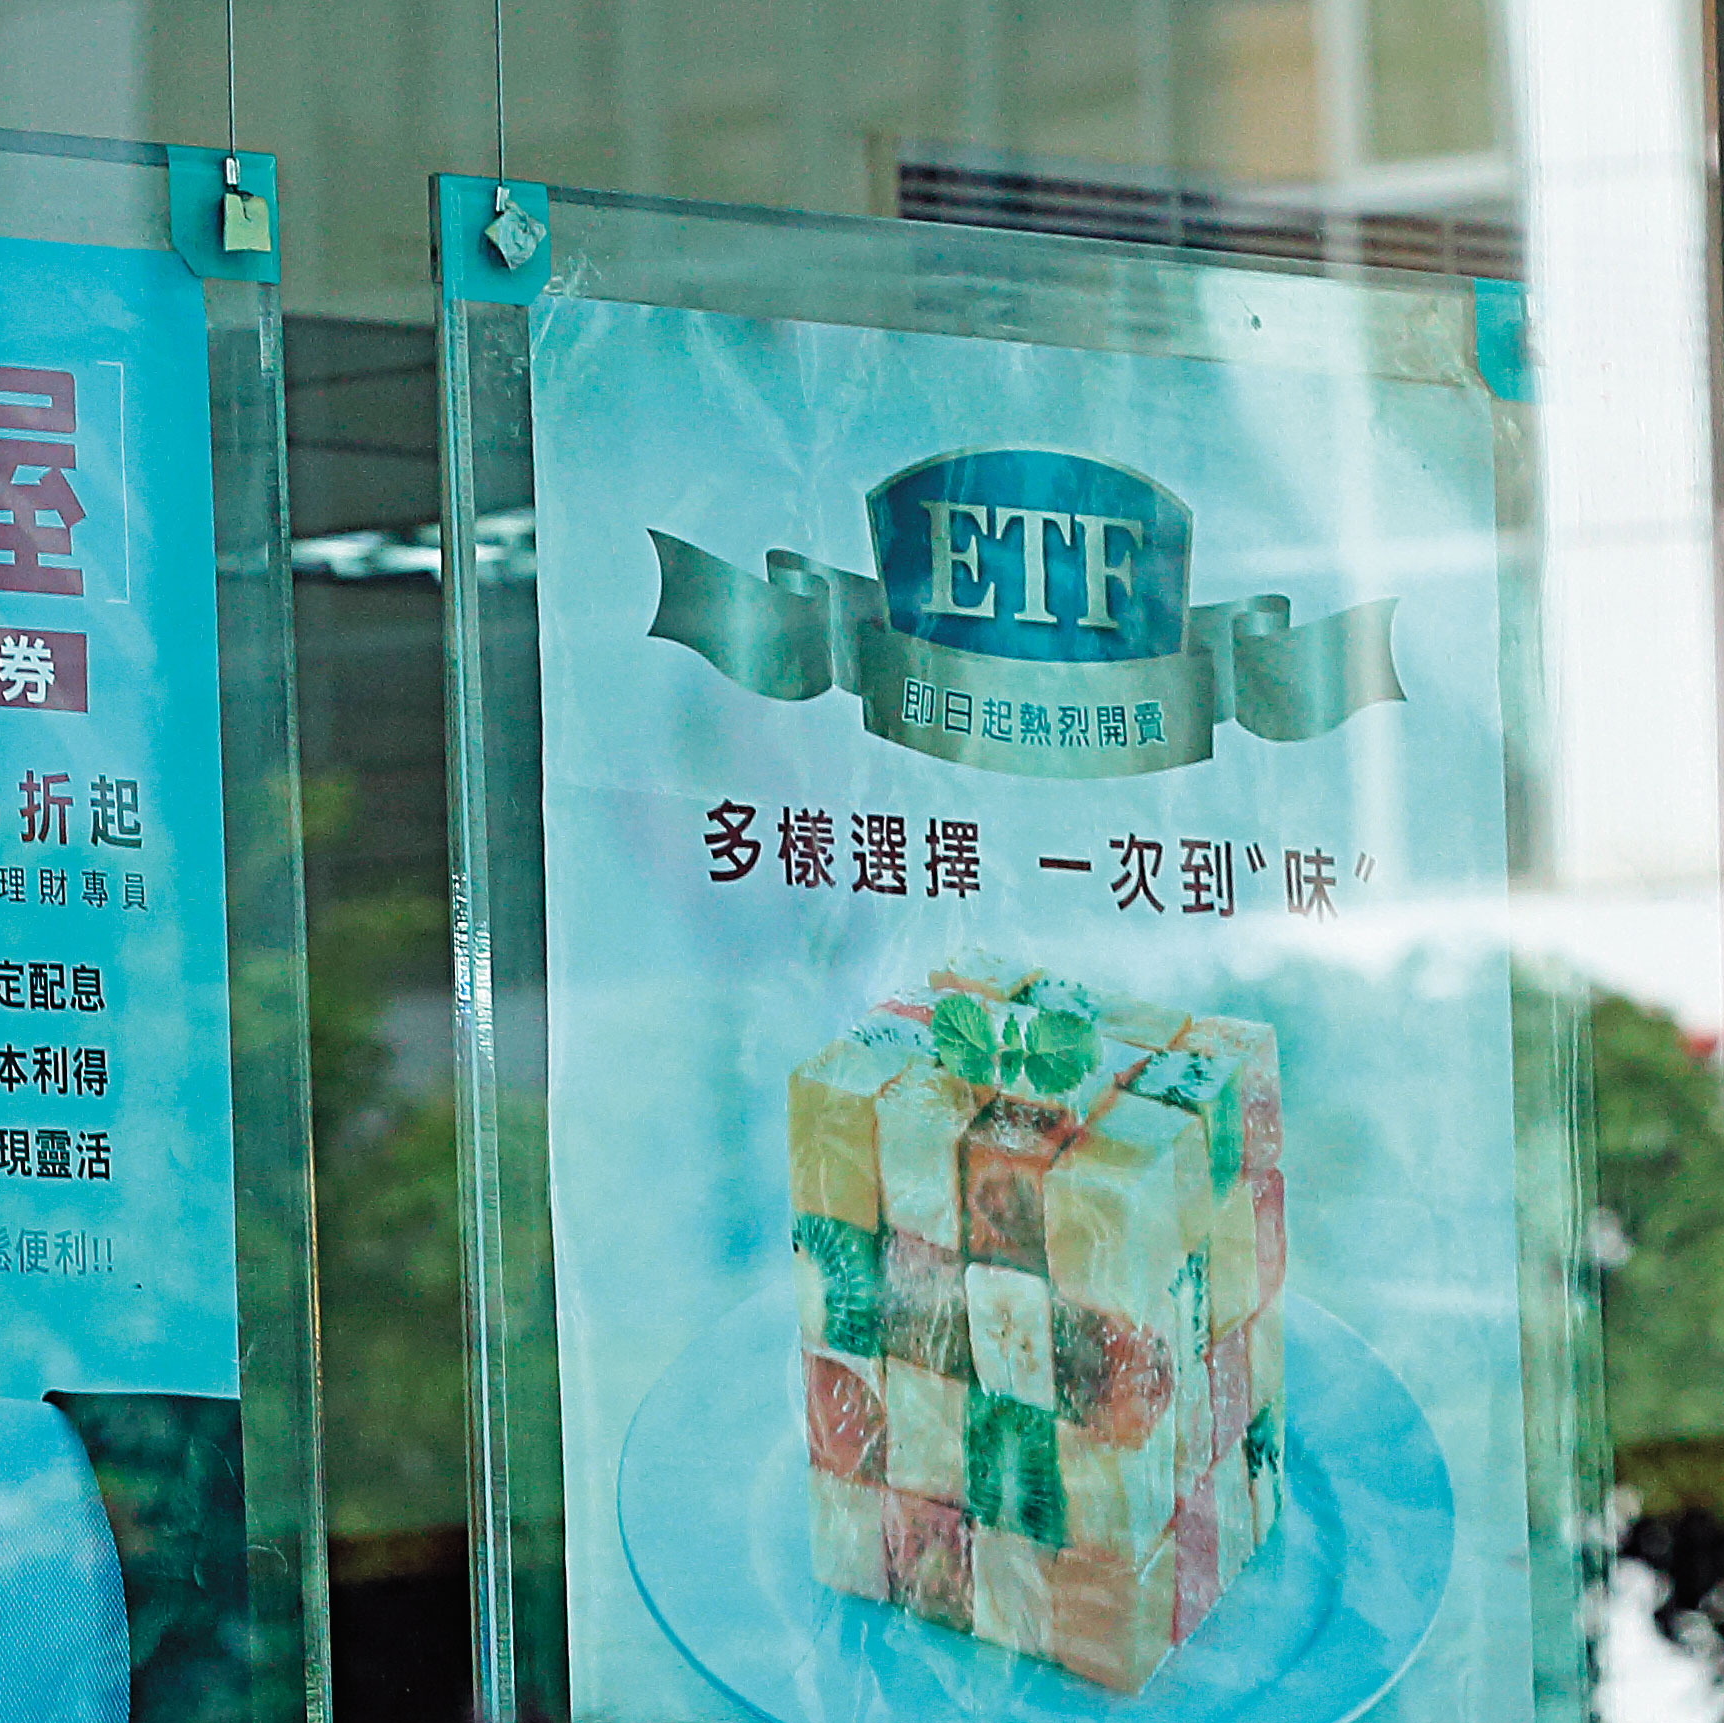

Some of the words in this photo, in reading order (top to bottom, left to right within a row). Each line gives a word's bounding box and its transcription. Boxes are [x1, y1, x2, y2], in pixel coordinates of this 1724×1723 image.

[918, 499, 1145, 632] ETF
[901, 676, 1167, 750] 即日起熱烈開賣
[703, 799, 984, 900] 多樣選擇
